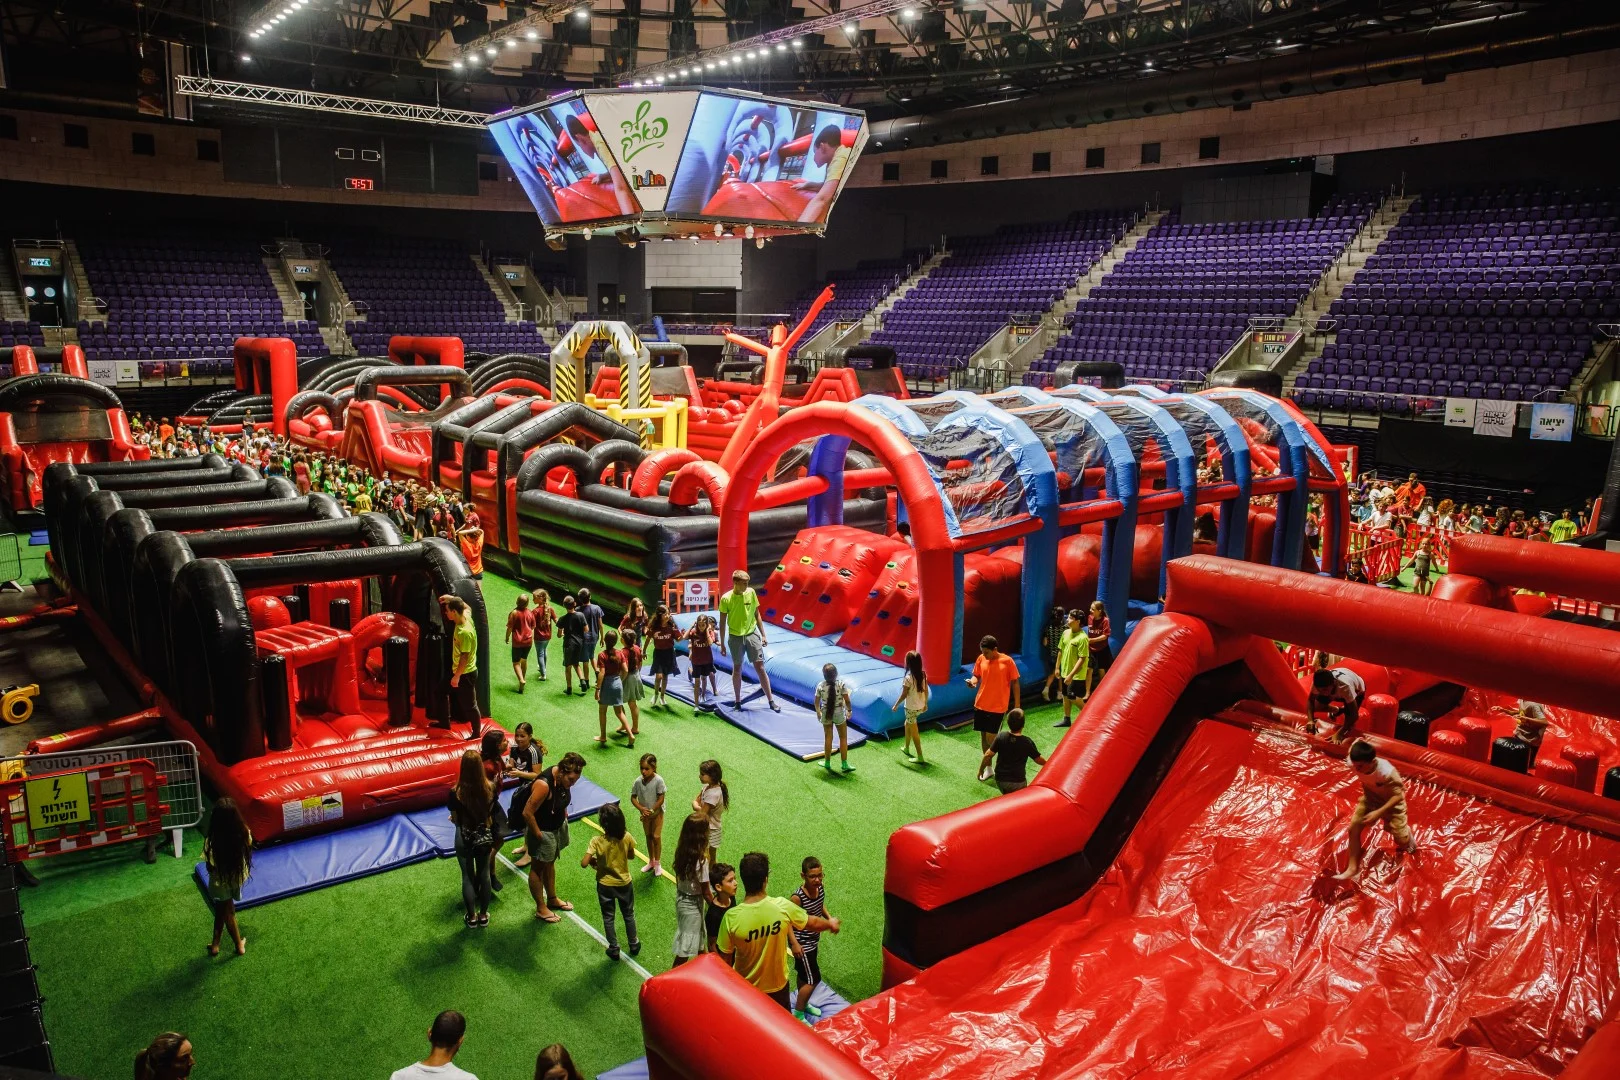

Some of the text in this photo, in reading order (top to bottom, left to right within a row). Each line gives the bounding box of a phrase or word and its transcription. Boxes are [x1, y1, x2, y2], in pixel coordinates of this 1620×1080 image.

[352, 179, 372, 189] 9:57
[535, 305, 550, 324] D4
[1539, 417, 1565, 426] יציאה
[89, 752, 122, 765] היכל
[40, 800, 78, 814] זהירות
[42, 811, 78, 824] חשמל
[744, 920, 781, 943] צוות
